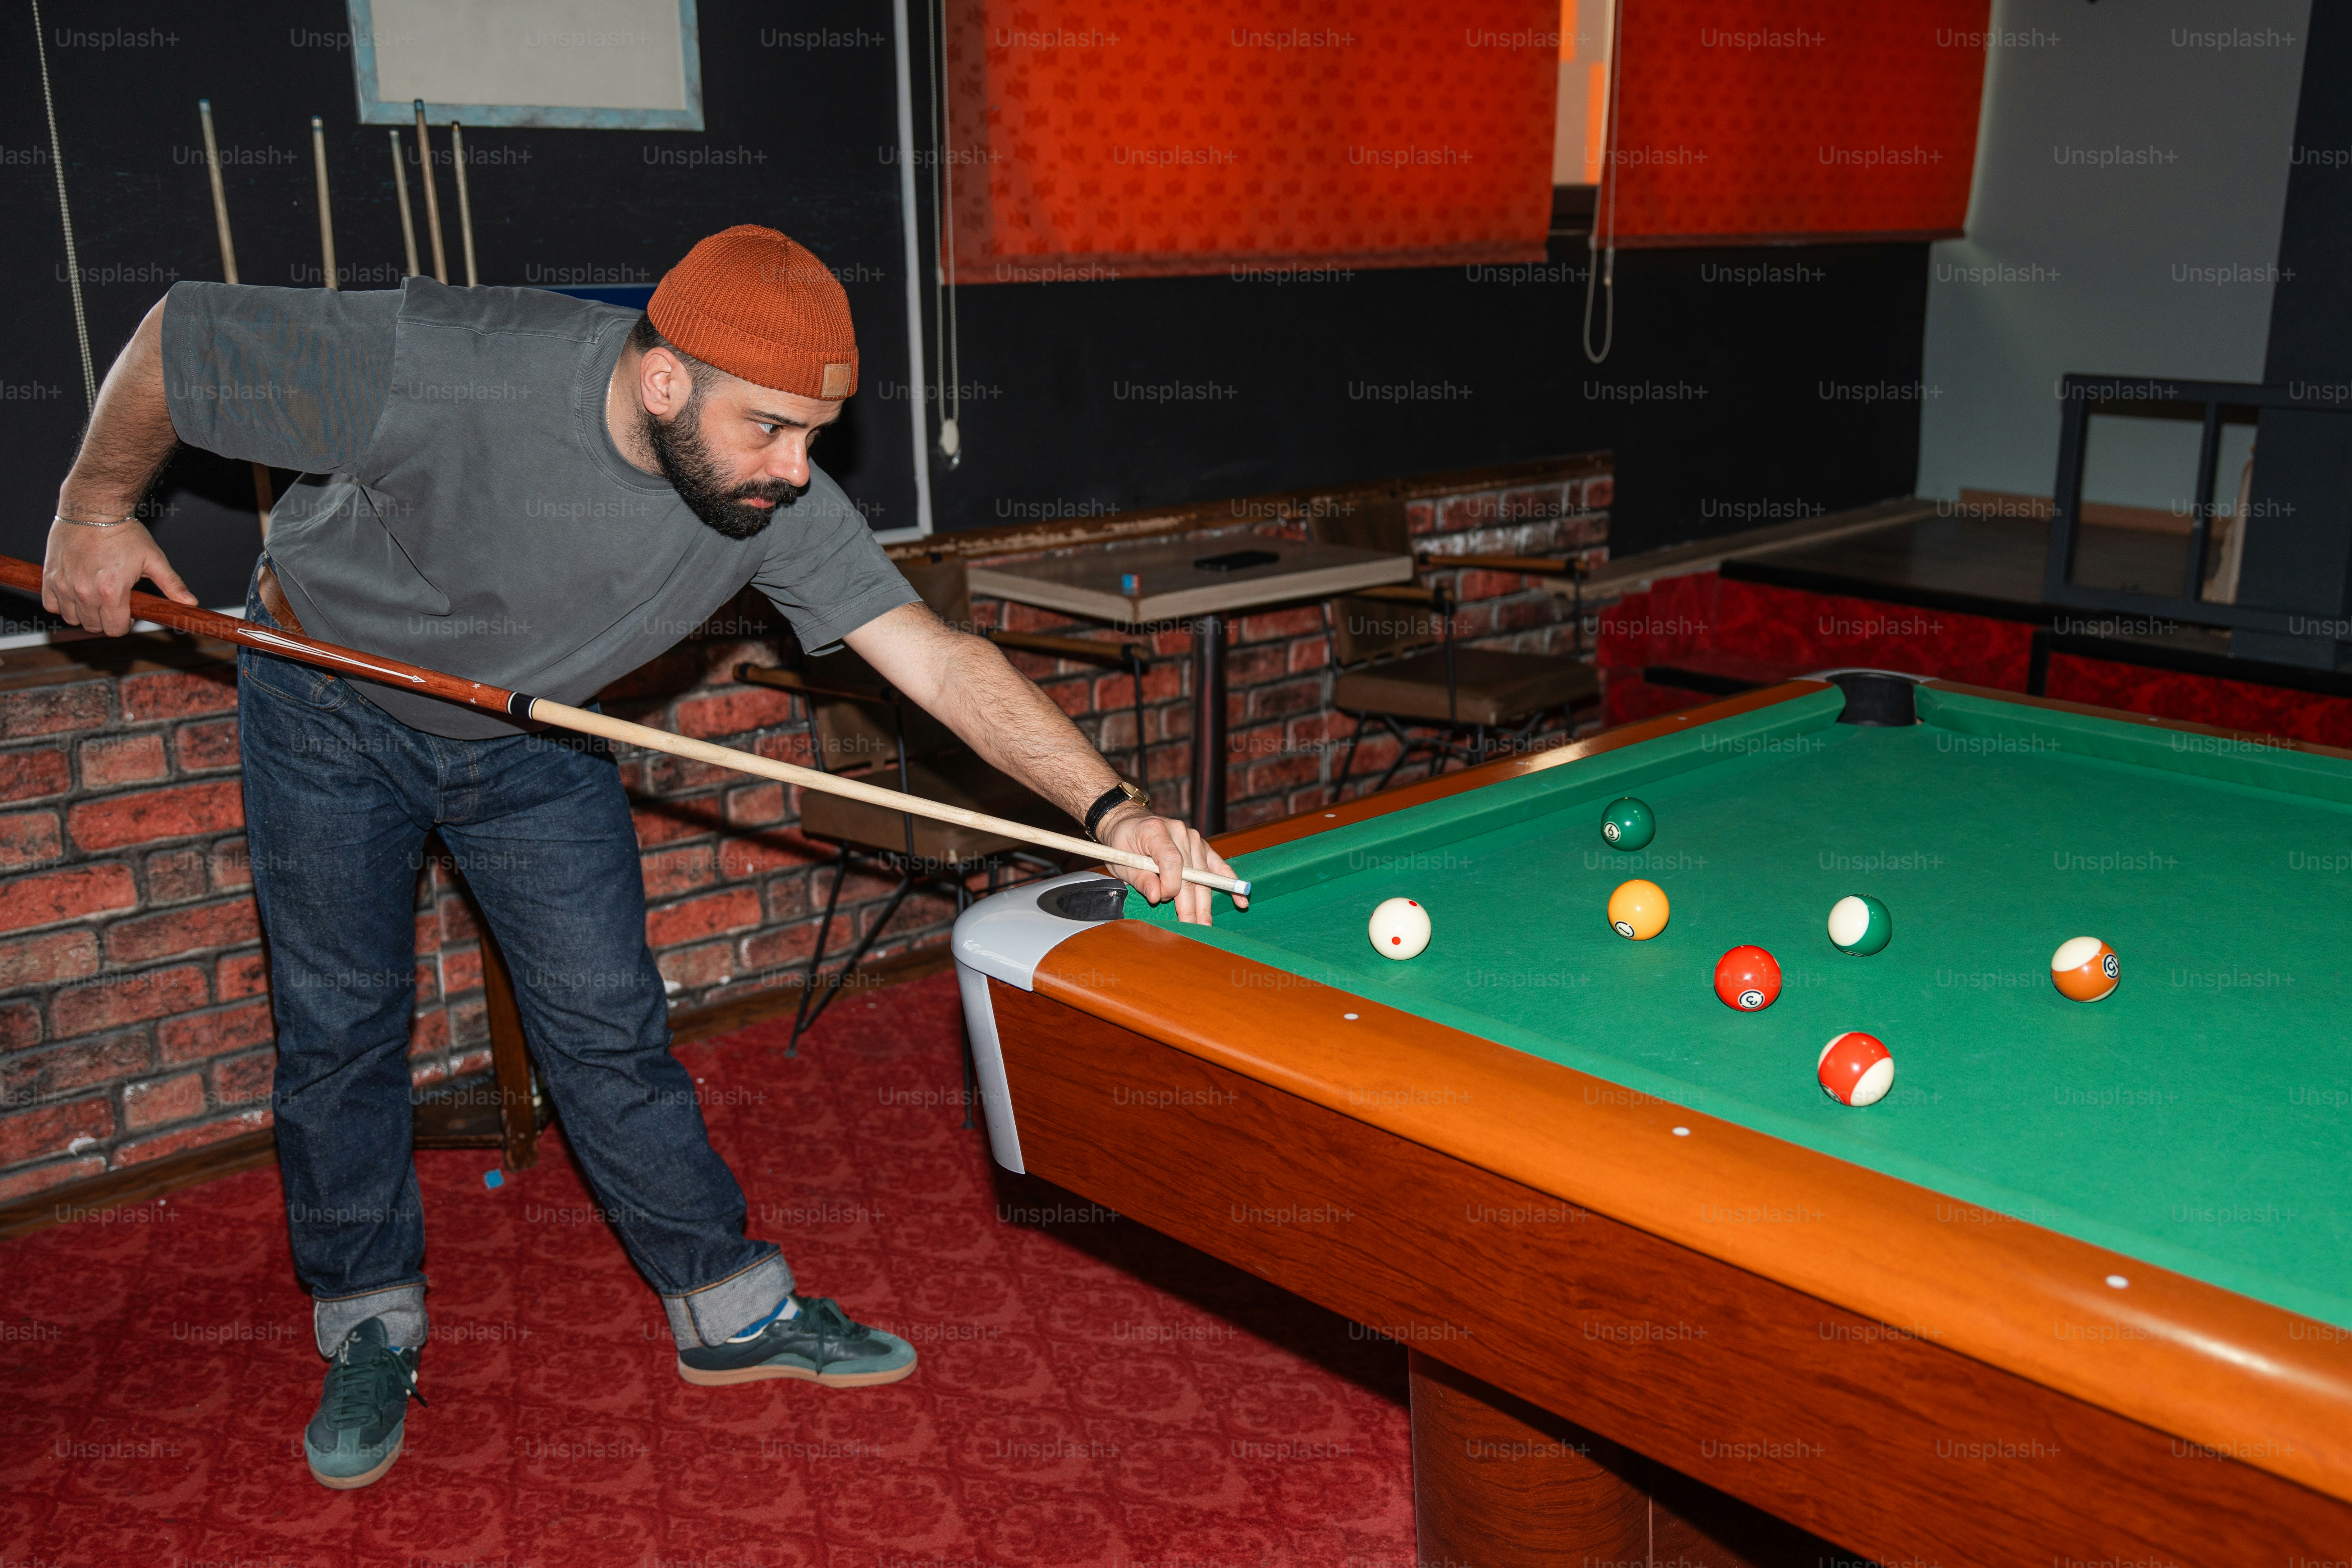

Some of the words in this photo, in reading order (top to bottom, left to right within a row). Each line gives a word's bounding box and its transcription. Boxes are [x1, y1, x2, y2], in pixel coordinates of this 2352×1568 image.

[1608, 826, 1614, 837] 6
[1619, 926, 1630, 935] 1
[2107, 957, 2118, 975] 15
[1746, 996, 1757, 1005] 3
